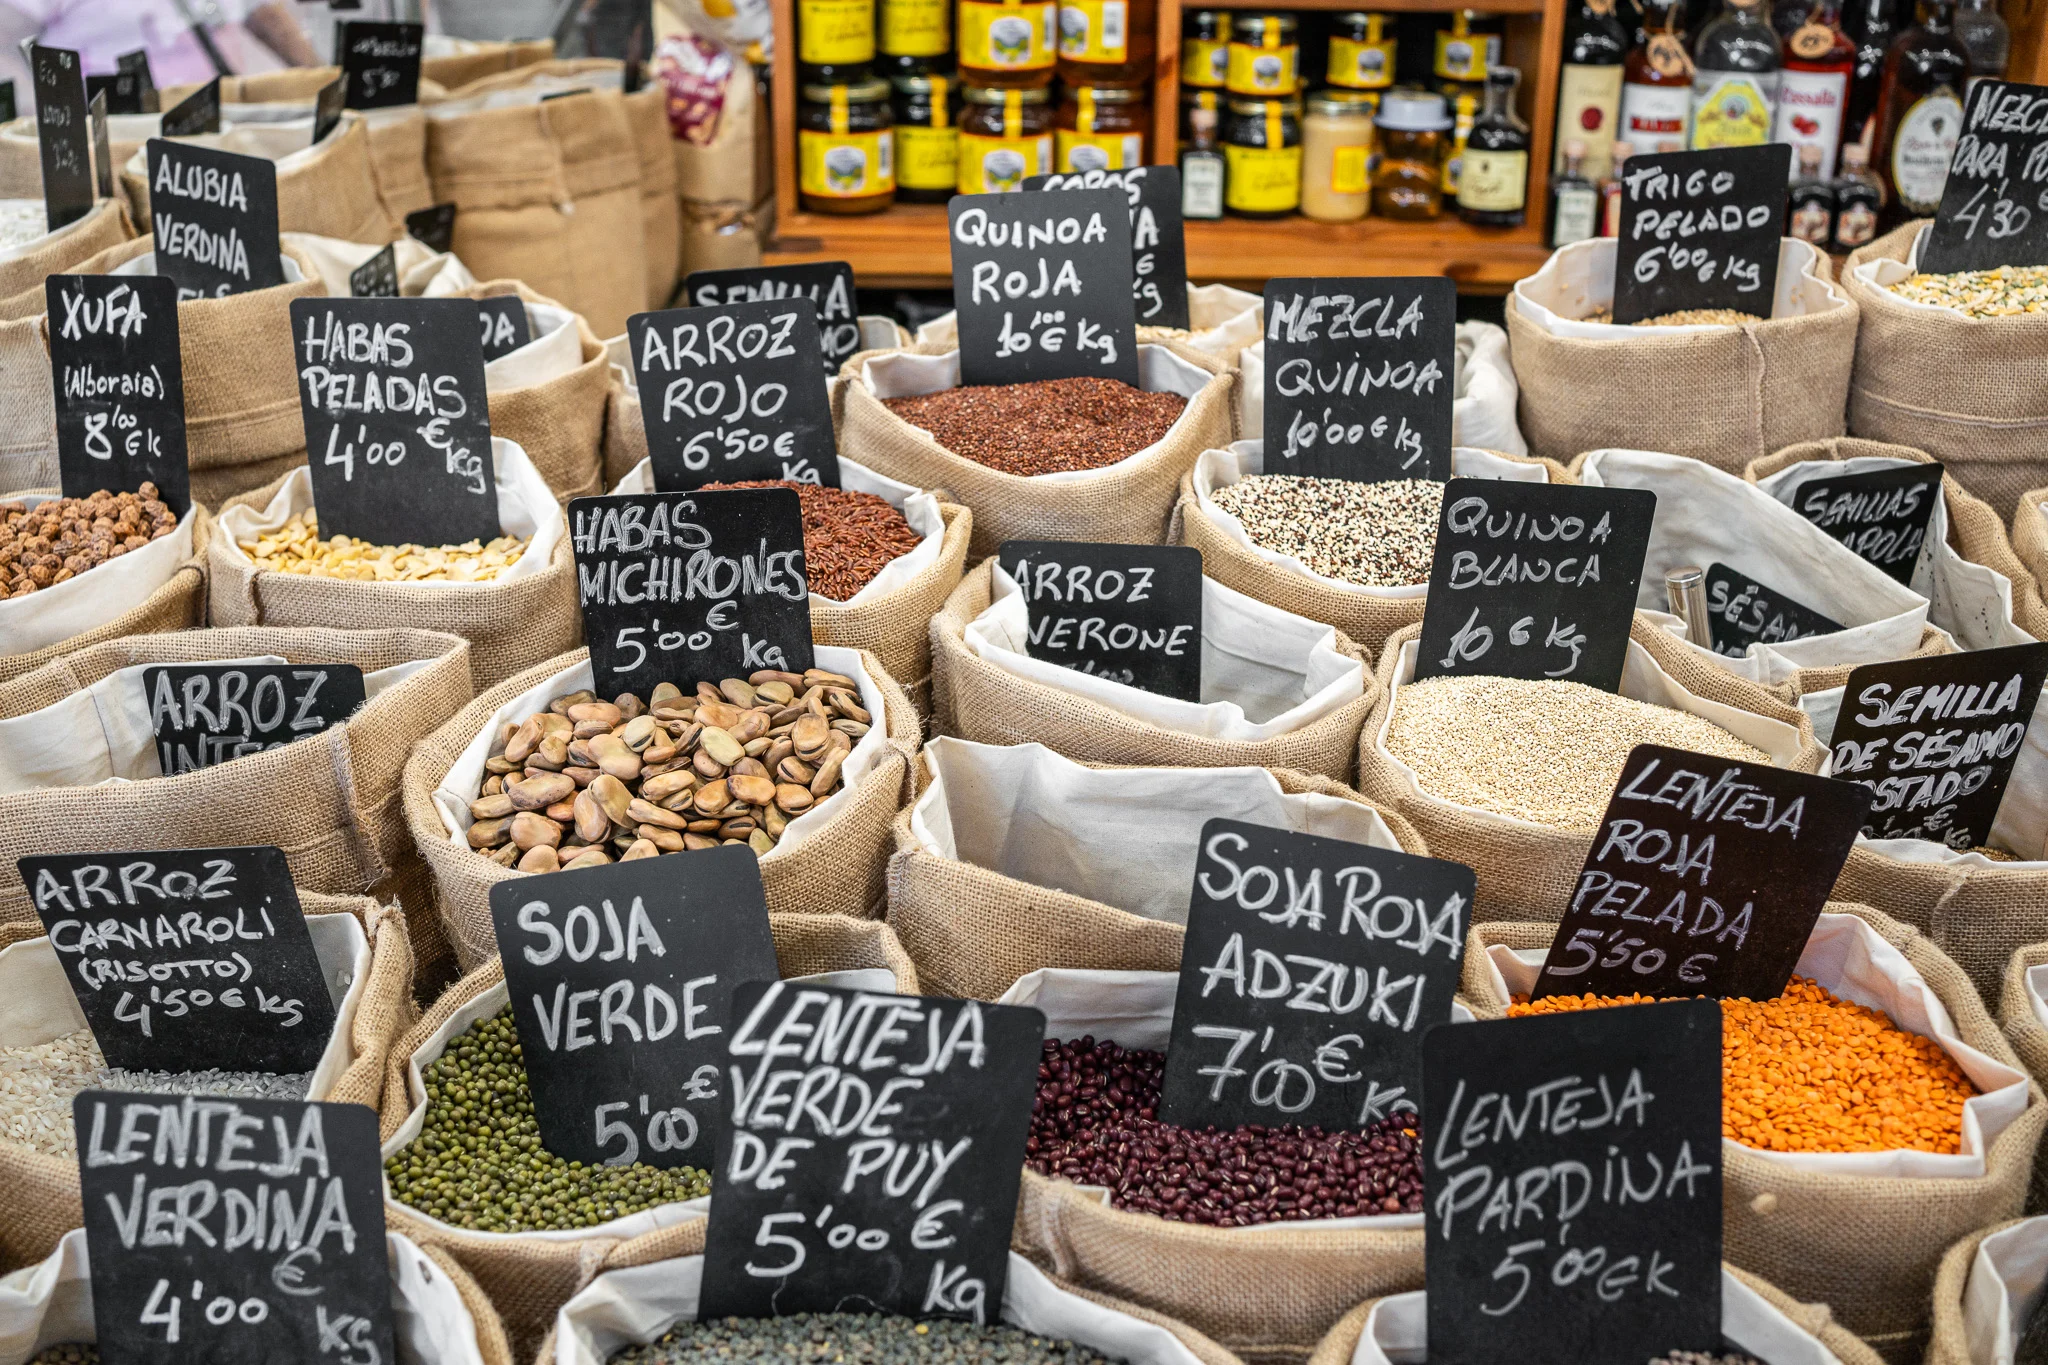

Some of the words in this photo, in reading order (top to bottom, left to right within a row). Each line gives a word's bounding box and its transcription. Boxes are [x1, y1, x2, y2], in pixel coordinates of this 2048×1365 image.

[155, 153, 247, 212] ALUBIA
[1625, 166, 1735, 201] TRIGO
[1952, 133, 2008, 179] PARA
[156, 213, 249, 281] VERDINA
[955, 208, 1107, 249] QUINOA
[1632, 205, 1770, 240] PELADO
[972, 258, 1082, 305] ROJA
[61, 284, 147, 341] XUFA
[302, 311, 414, 368] HABAS
[1267, 293, 1424, 343] MEZCLA
[641, 313, 798, 371] ARROZ
[301, 366, 467, 419] PELADAS
[663, 375, 788, 424] ROJO
[573, 500, 713, 553] HABAS
[1447, 497, 1612, 545] QUINOA
[579, 538, 807, 607] MICHIRONES
[1014, 559, 1155, 603] ARROZ
[1449, 551, 1600, 589] BLANCA
[152, 670, 328, 742] ARROZ
[1855, 674, 2022, 728] SEMILLA
[1831, 738, 1889, 776] DE
[1619, 758, 1806, 840] LENTEJA
[1597, 819, 1715, 886] ROJA
[36, 859, 238, 912] ARROZ
[1199, 832, 1327, 932] SOJA
[1335, 866, 1467, 960] ROJA
[1571, 870, 1753, 950] PELADA
[517, 896, 667, 966] SOJA
[78, 951, 252, 991] (RISOTTO)
[1200, 933, 1427, 1032] ADZUKI
[533, 974, 723, 1052] VERDE
[729, 981, 985, 1075] LENTEJA
[730, 1054, 925, 1138] VERDE
[1434, 1068, 1655, 1170] LENTEJA
[86, 1096, 329, 1178] LENTEJA
[729, 1130, 815, 1190] DE
[842, 1136, 973, 1209] PUY
[105, 1173, 356, 1254] VERDINA
